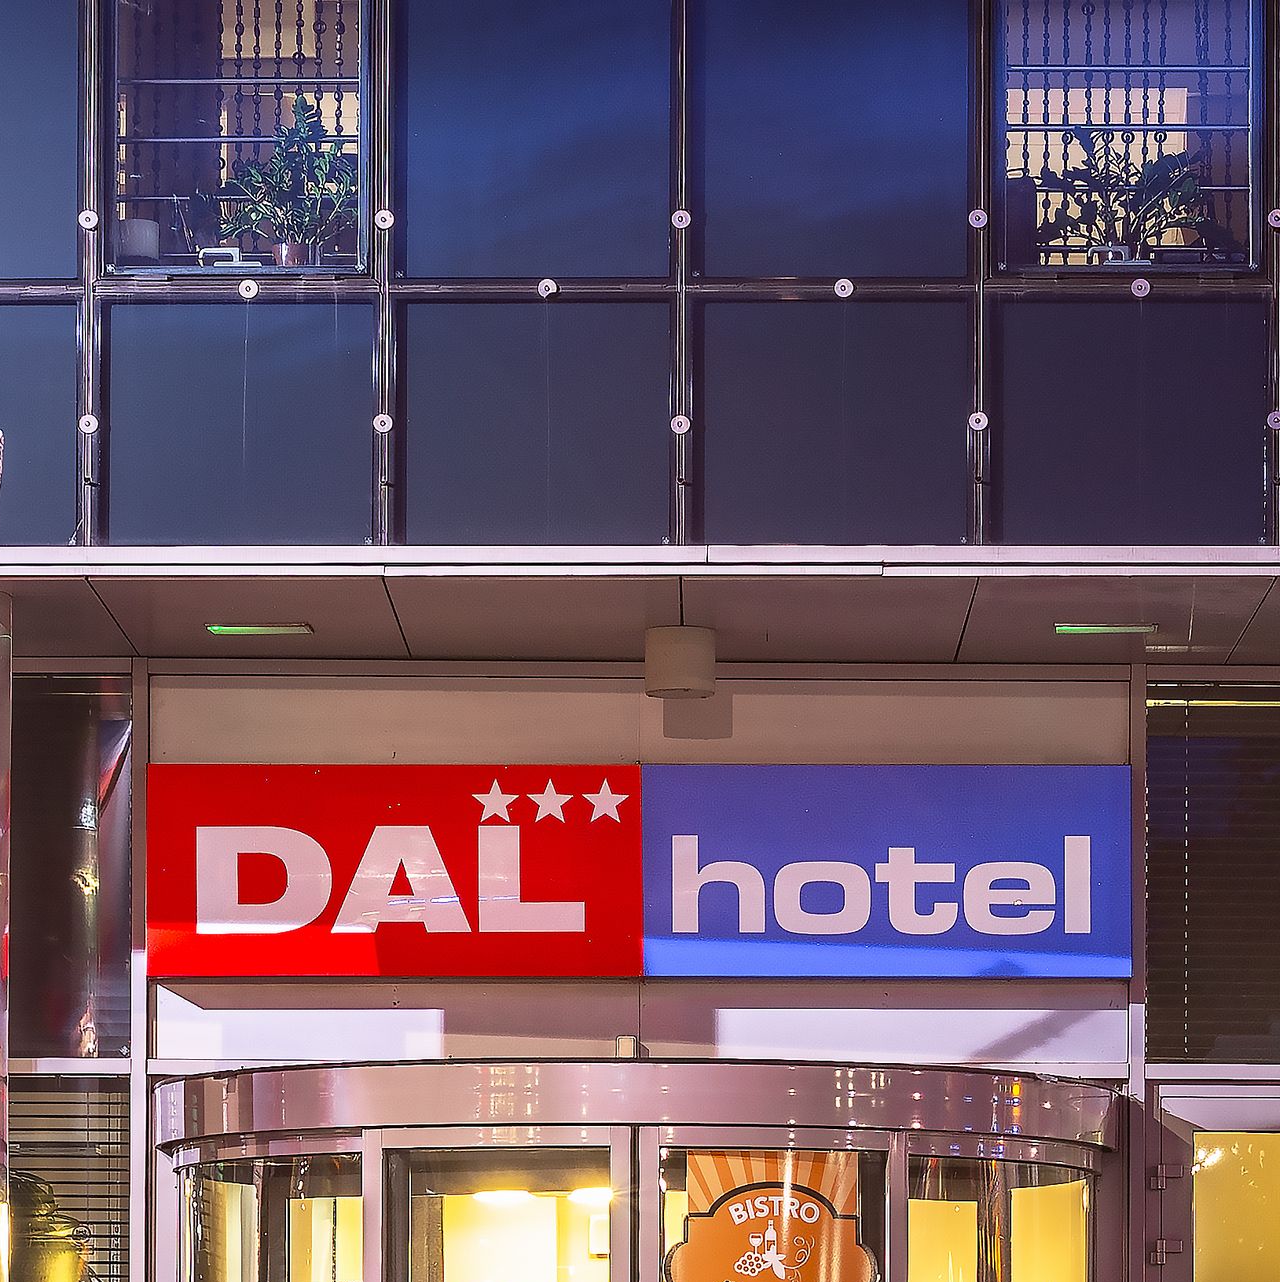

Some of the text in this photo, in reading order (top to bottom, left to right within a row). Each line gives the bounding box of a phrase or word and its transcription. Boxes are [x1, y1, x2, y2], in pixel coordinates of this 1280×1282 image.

[196, 825, 1091, 936] DAL hotel
[728, 1196, 821, 1225] BISTRO
